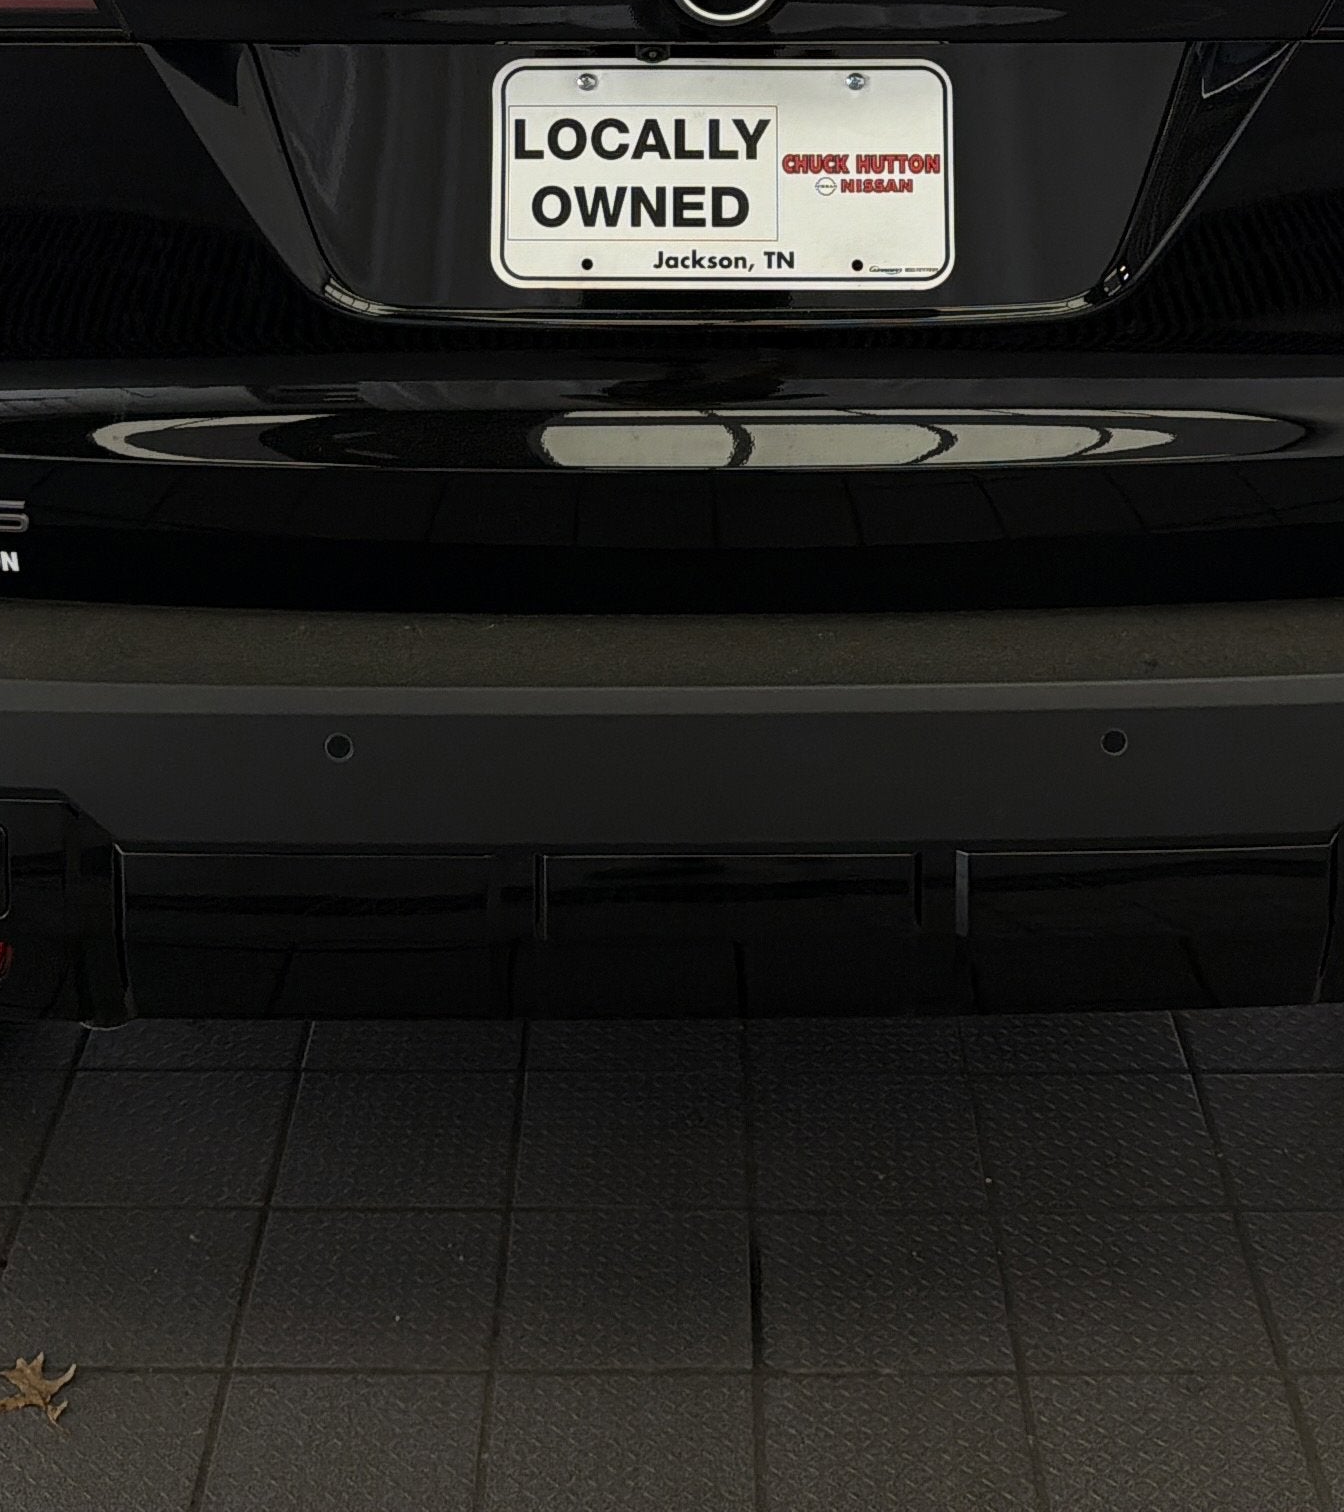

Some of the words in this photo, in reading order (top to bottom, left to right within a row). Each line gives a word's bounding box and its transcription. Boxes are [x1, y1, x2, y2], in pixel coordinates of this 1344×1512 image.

[514, 118, 772, 161] LOCALLY
[782, 153, 850, 175] CHUCK
[855, 153, 941, 175] HUTTON
[840, 178, 914, 193] NISSAN
[531, 185, 750, 228] OWNED
[653, 249, 755, 272] Jackson,
[763, 251, 796, 270] TN
